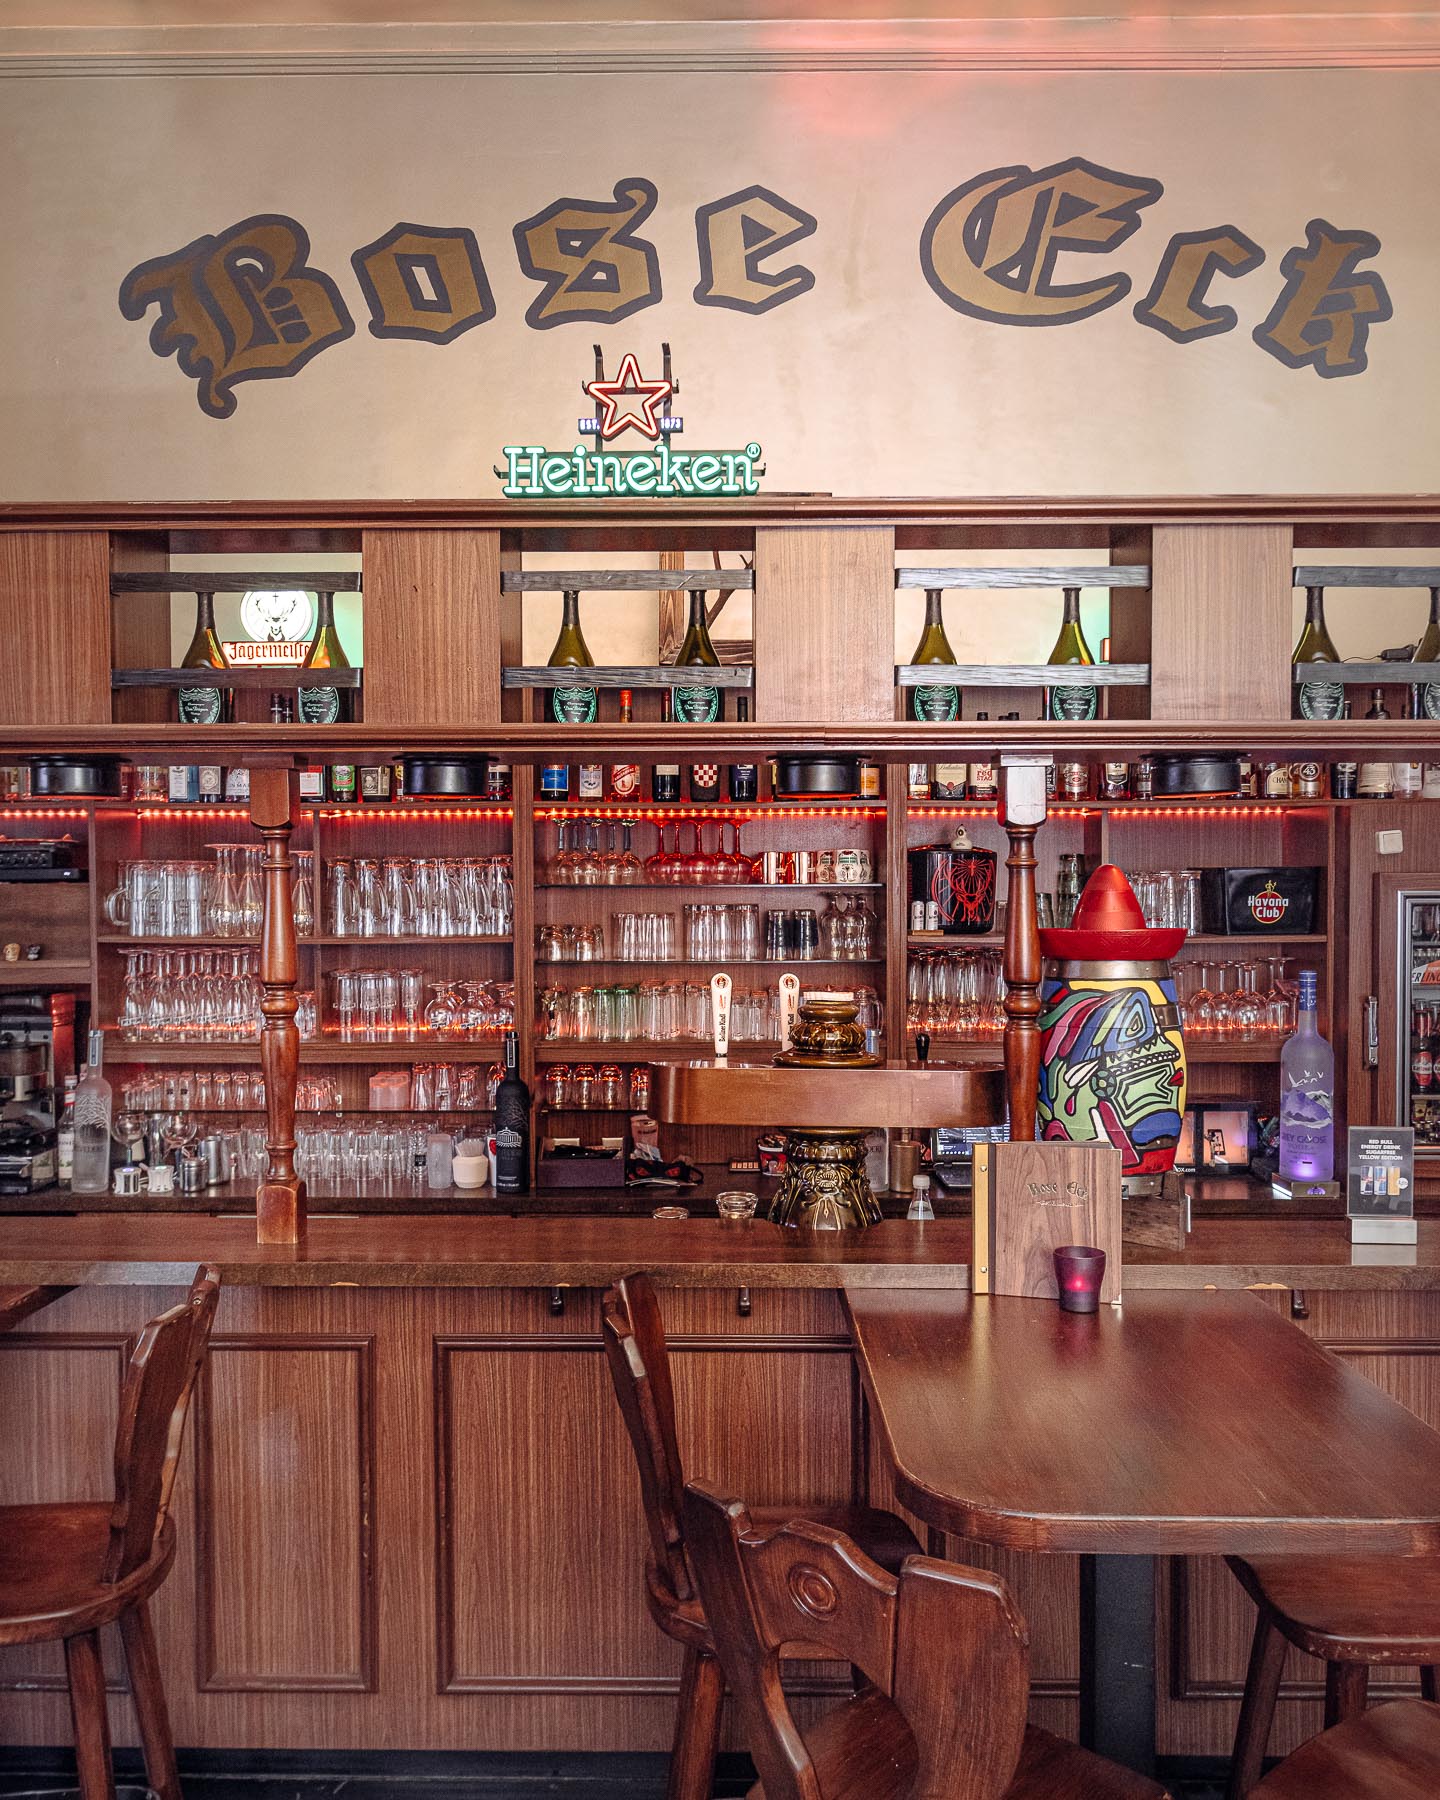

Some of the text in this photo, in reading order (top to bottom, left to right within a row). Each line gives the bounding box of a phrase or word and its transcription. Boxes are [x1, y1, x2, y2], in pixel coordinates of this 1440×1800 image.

[919, 156, 1394, 379] Eck
[503, 445, 759, 498] Heineken
[1303, 765, 1316, 776] 43
[1248, 896, 1289, 906] Havana
[1256, 907, 1280, 918] Club
